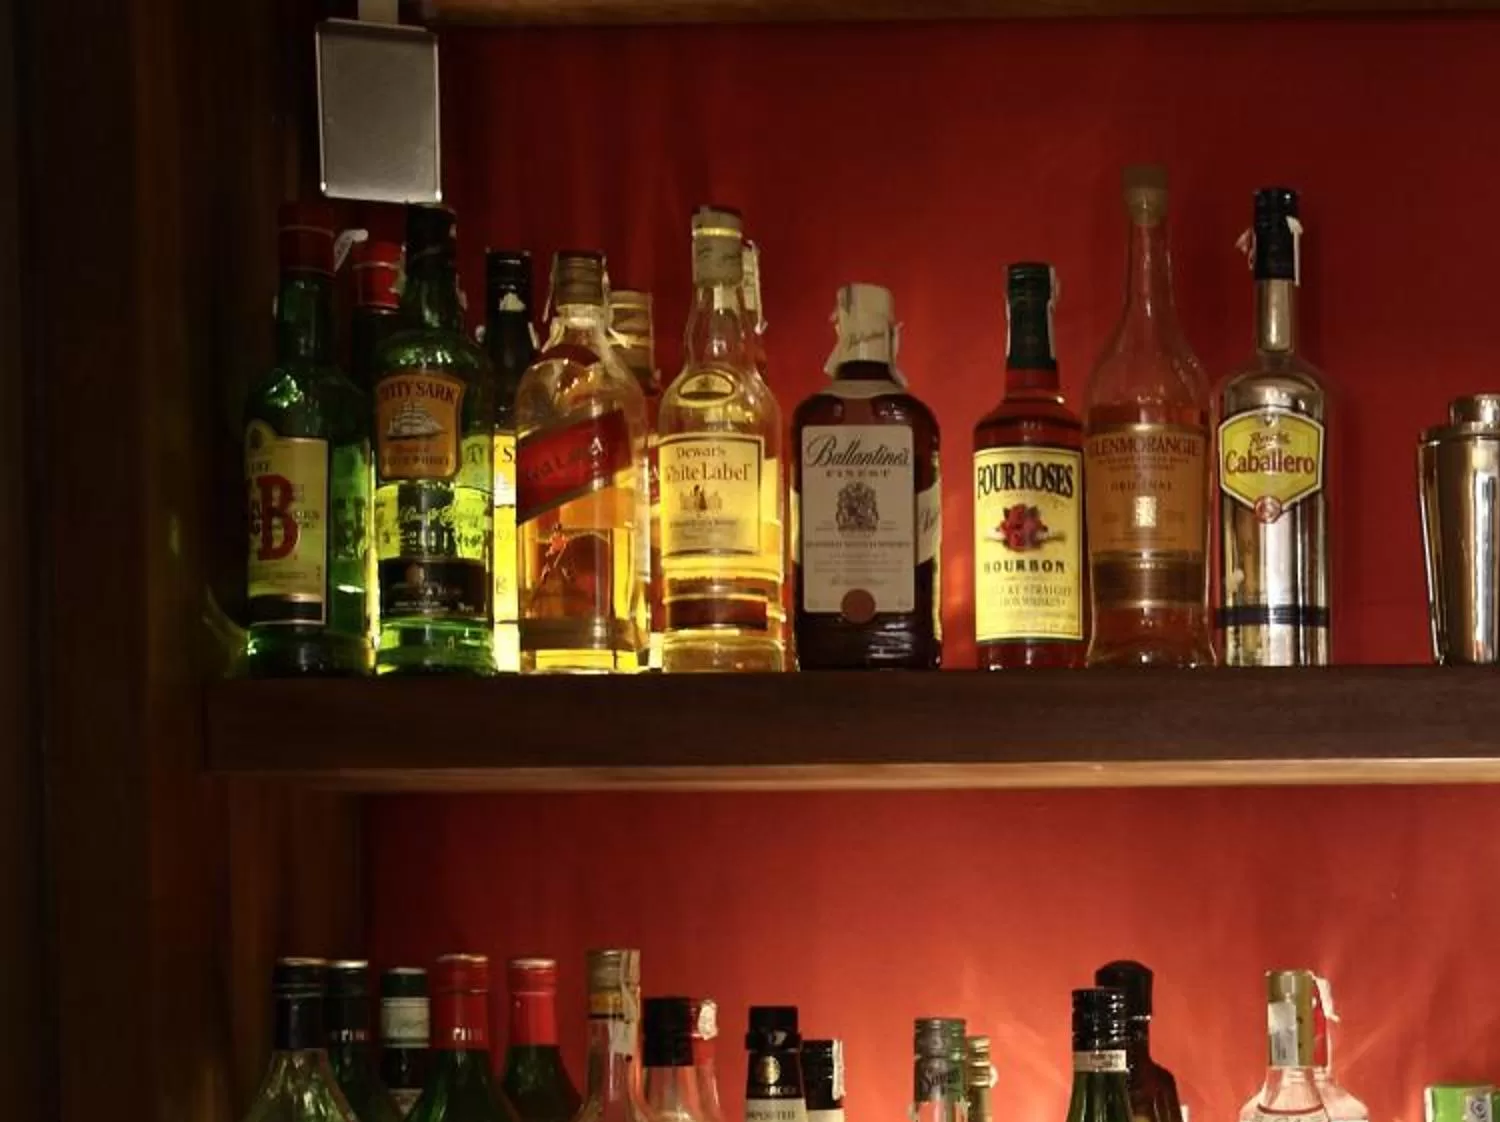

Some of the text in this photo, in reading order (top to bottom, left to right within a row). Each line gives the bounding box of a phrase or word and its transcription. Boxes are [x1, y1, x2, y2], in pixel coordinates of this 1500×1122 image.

[415, 383, 455, 404] SARK
[805, 433, 909, 467] Ballantine's
[1091, 434, 1200, 457] GLENMRANGIE
[702, 462, 750, 481] Label
[1225, 450, 1315, 476] Caballero
[977, 461, 1073, 500] FOUR ROSES
[984, 559, 1065, 574] BOURBON
[746, 1108, 796, 1121] MPORTED
